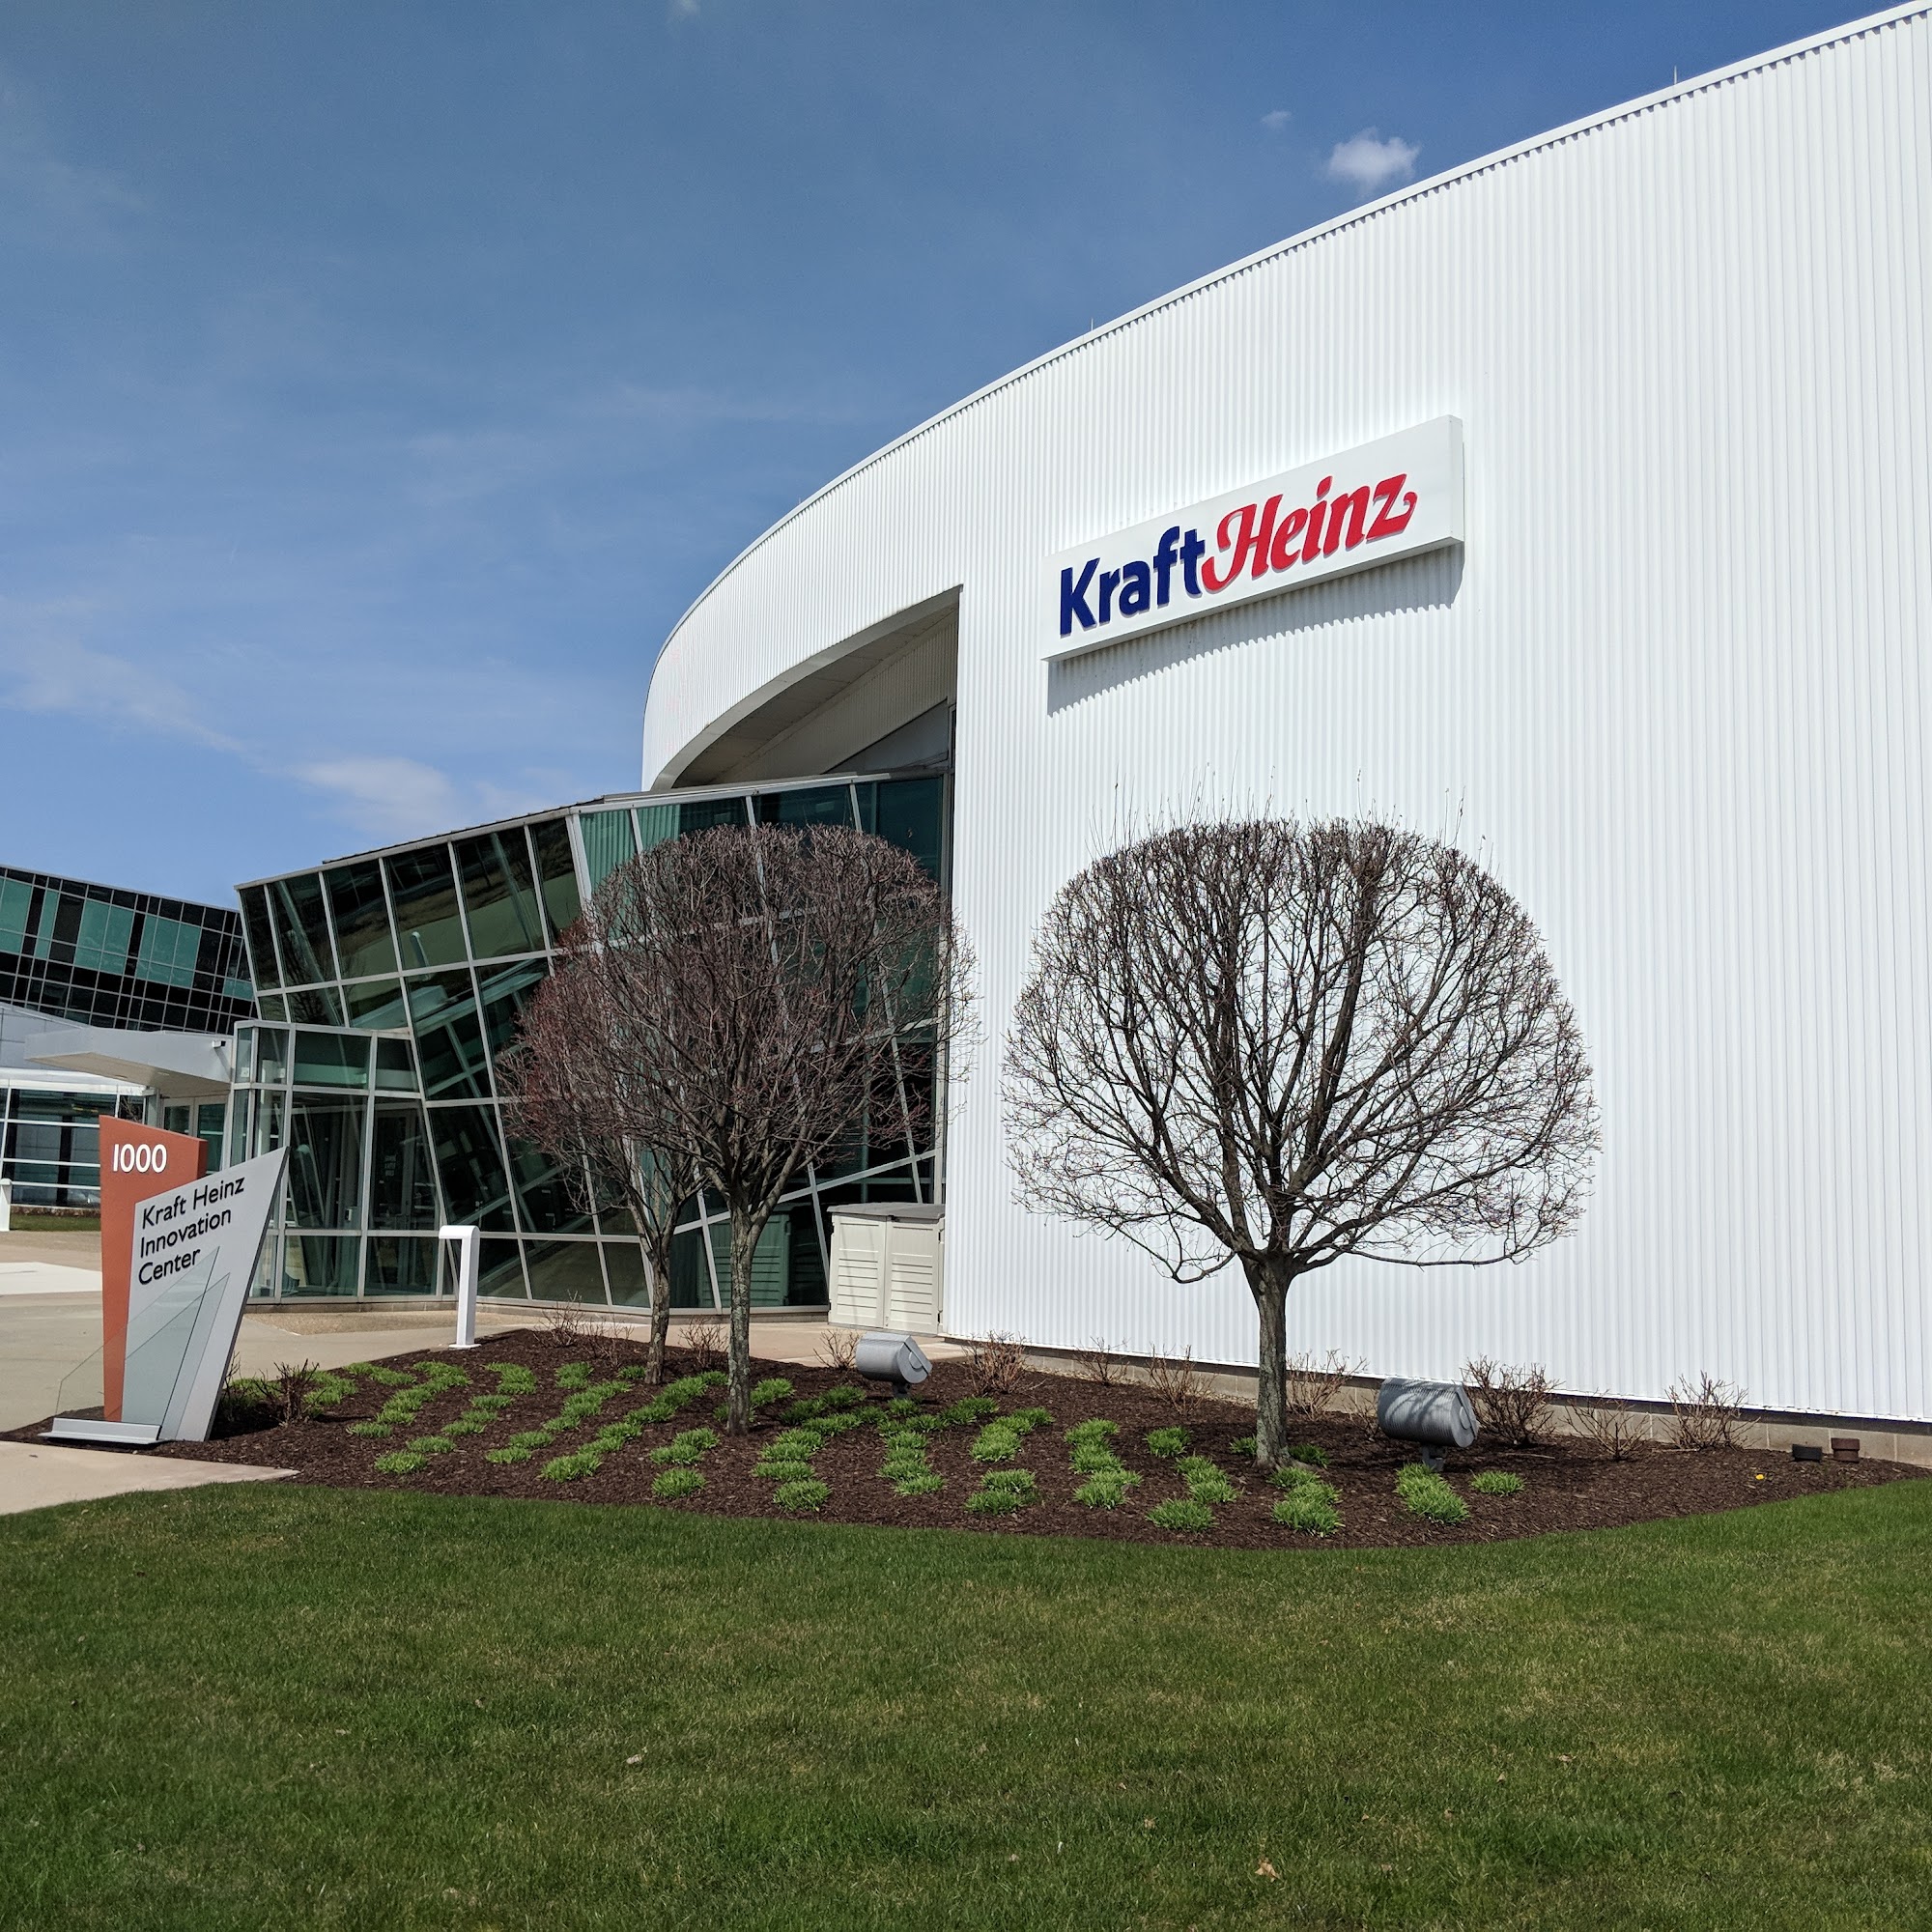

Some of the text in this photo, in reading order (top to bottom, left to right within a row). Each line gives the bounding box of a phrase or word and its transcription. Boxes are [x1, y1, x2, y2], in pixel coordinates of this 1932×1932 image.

[113, 1144, 167, 1173] 1000
[142, 1177, 244, 1229] Kraft Heinz
[140, 1209, 231, 1258] Innovation
[138, 1249, 201, 1285] Center
